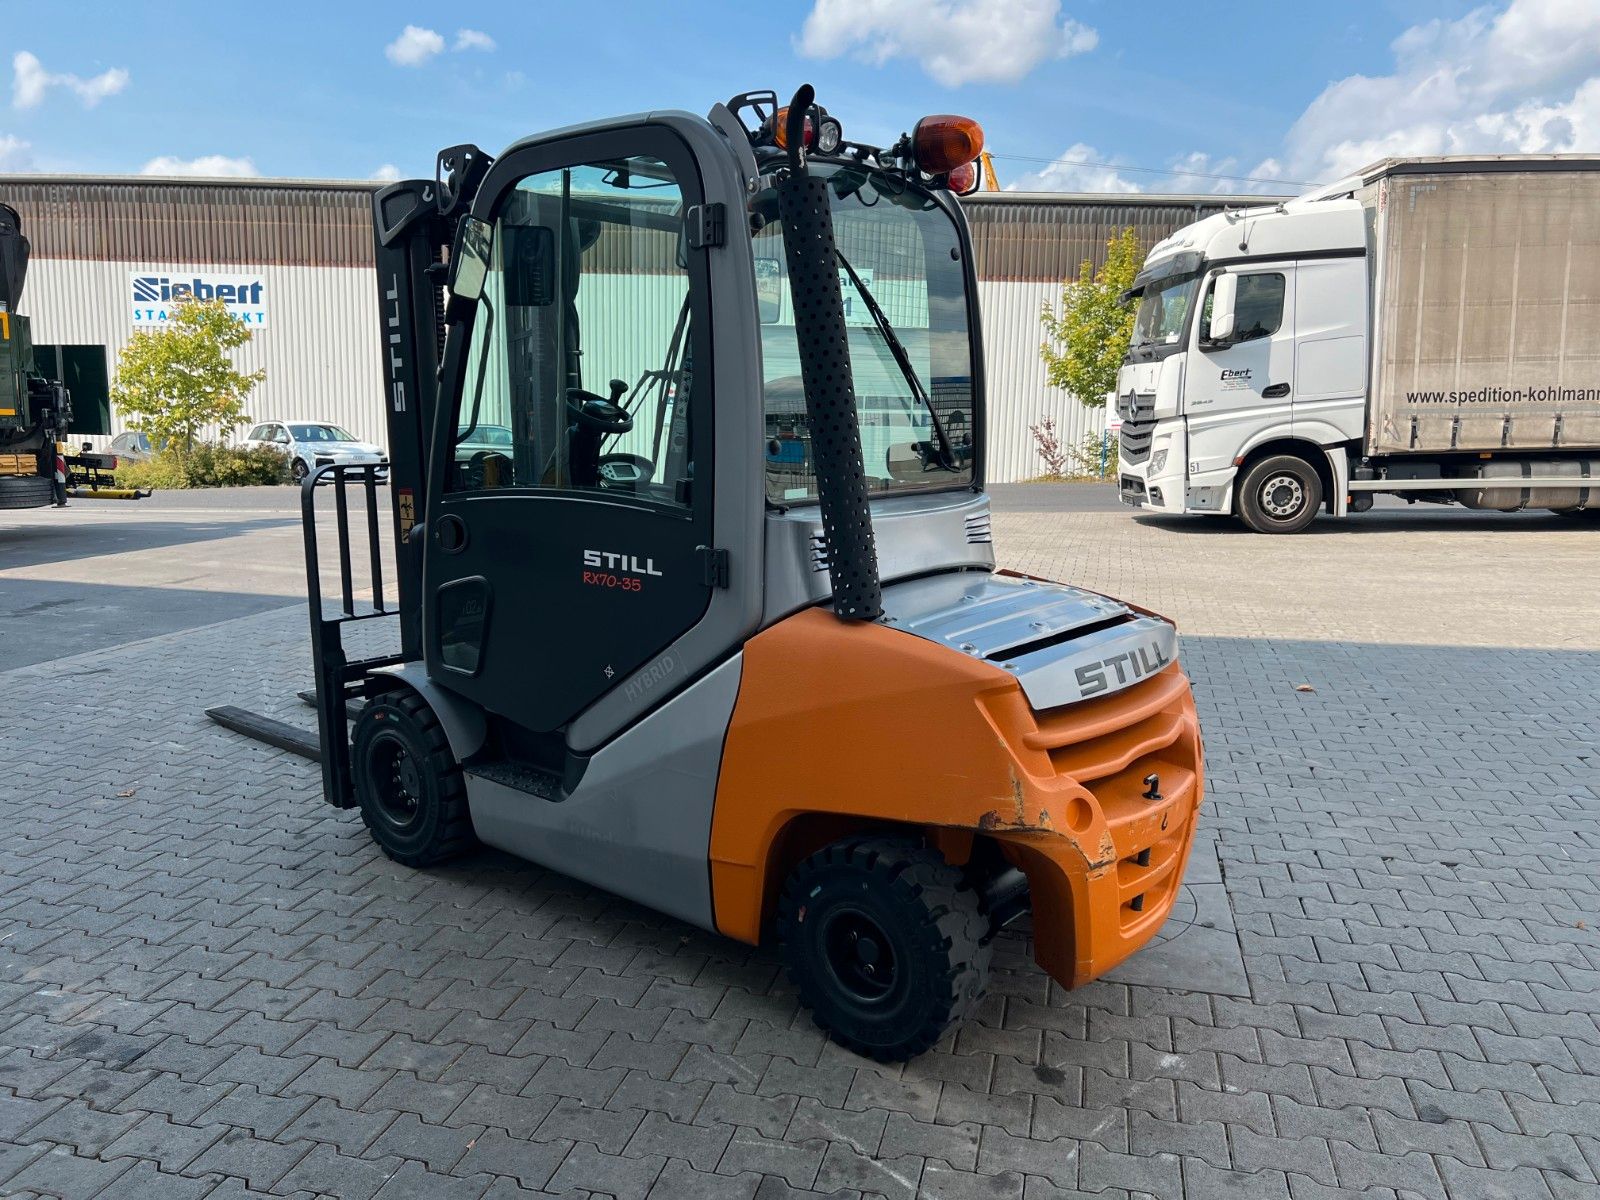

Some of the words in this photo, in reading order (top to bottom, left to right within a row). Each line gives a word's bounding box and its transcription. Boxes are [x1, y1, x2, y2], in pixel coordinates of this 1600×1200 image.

[133, 277, 263, 304] Siebert
[135, 309, 264, 323] STARKT
[387, 273, 406, 412] STILL
[1221, 368, 1252, 380] Ebert
[1190, 462, 1199, 472] 51
[584, 549, 662, 576] STILL
[583, 571, 641, 591] RX70-35
[625, 656, 674, 701] HYBRID
[1074, 641, 1169, 697] STILL
